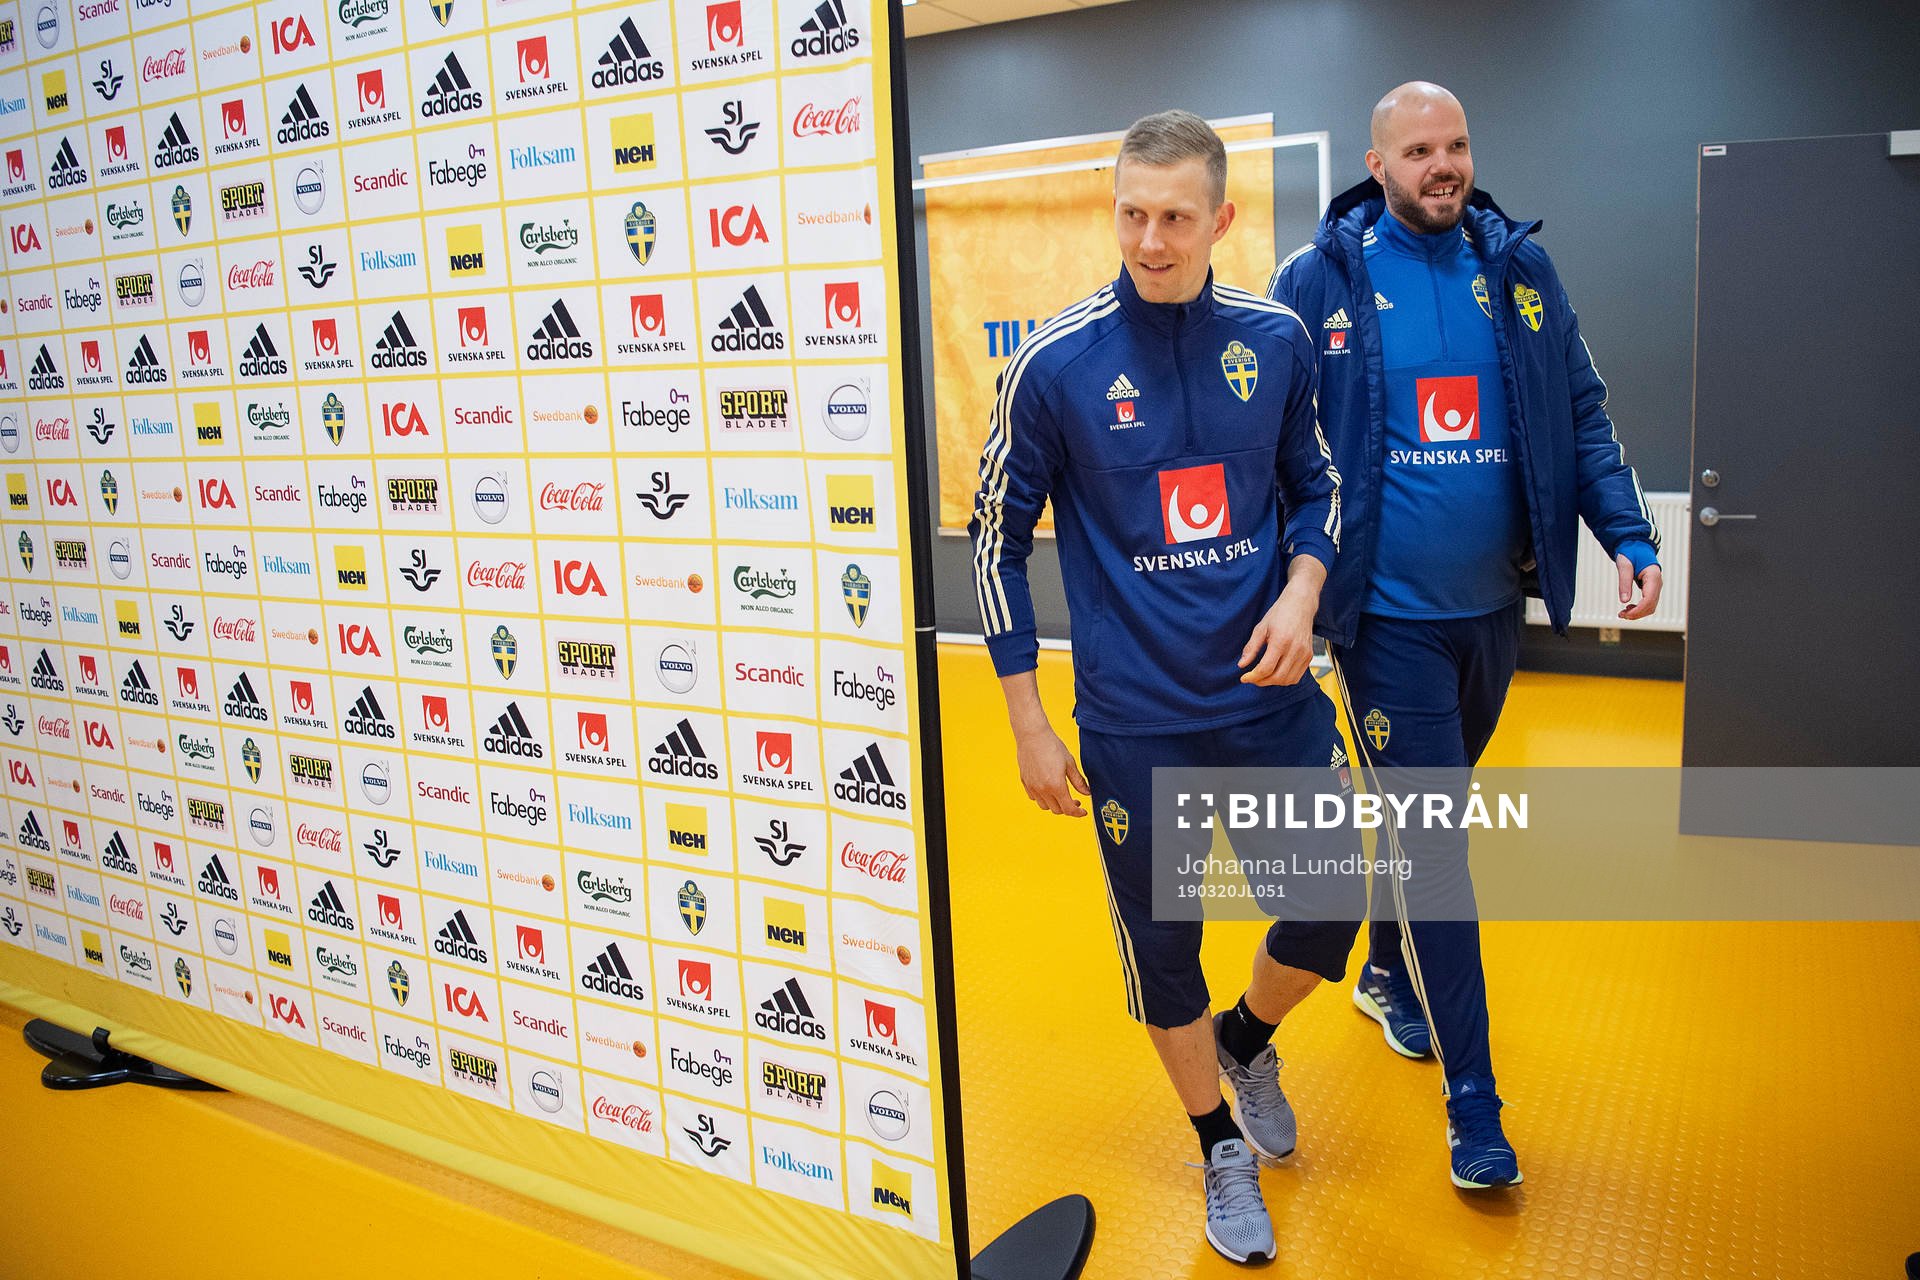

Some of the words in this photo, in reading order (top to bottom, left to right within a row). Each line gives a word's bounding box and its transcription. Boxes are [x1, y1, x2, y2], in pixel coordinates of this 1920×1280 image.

[338, 0, 389, 22] Carlsberg
[692, 55, 738, 71] SVENSKA
[741, 50, 762, 63] SPEL
[591, 60, 664, 90] adidas
[421, 90, 482, 117] adidas
[505, 86, 545, 101] SVENSKA
[547, 82, 568, 94] SPEL
[723, 100, 743, 126] SJ
[509, 145, 576, 170] Folksam
[48, 167, 87, 189] adidas
[428, 160, 487, 187] Fabege
[220, 181, 265, 210] SPORT
[709, 203, 769, 248] ICA
[797, 209, 863, 226] Swedbank
[519, 221, 579, 251] Carlsberg
[114, 273, 153, 299] SPORT
[17, 294, 53, 312] Scandic
[64, 288, 102, 312] Fabege
[119, 296, 153, 306] BLADET
[1376, 302, 1394, 311] das
[711, 322, 784, 352] adidas
[1323, 321, 1353, 329] adidas
[526, 332, 593, 361] adidas
[618, 343, 660, 354] SVENSKA
[663, 342, 685, 352] SPEL
[805, 335, 856, 346] SVENSKA
[858, 334, 877, 344] SPEL
[125, 358, 167, 384] adidas
[182, 369, 209, 378] SVENSKA
[209, 368, 224, 376] SPEL
[1227, 357, 1252, 365] SVERIGE
[28, 366, 64, 390] adidas
[719, 389, 788, 420] SPORT
[1106, 388, 1141, 401] adidas
[382, 401, 429, 437] ICA
[454, 405, 513, 426] Scandic
[532, 409, 582, 422] Swedbank
[622, 399, 691, 434] Fabege
[829, 404, 866, 415] VOLVO
[724, 419, 788, 429] BLADET
[1109, 423, 1133, 432] SVENSKA
[1133, 421, 1146, 429] SPEL
[1390, 450, 1471, 465] SVENSKA
[1475, 448, 1509, 464] SPEL
[47, 478, 78, 507] ICA
[387, 477, 438, 504] SPORT
[651, 471, 670, 495] SJ
[392, 502, 438, 512] BLADET
[476, 492, 503, 503] VOLVO
[539, 481, 606, 513] Coca-Cola
[724, 486, 799, 511] Folksam
[411, 548, 427, 569] SJ
[1133, 547, 1221, 573] SVENSKA
[1224, 538, 1260, 562] SPEL
[467, 560, 527, 591] Coca-Cola
[553, 559, 608, 597] ICA
[634, 574, 686, 590] Swedbank
[733, 565, 797, 597] Carlsberg
[172, 604, 184, 622] SJ
[338, 623, 381, 658] ICA
[557, 641, 616, 669] SPORT
[661, 661, 692, 672] VOLVO
[31, 675, 64, 692] adidas
[562, 666, 616, 679] BLADET
[735, 662, 805, 687] Scandic
[75, 686, 97, 695] SVENSKA
[97, 689, 109, 697] SPEL
[833, 670, 896, 711] Fabege
[284, 716, 312, 726] SVENSKA
[313, 720, 328, 729] SPEL
[178, 733, 215, 760] Carlsberg
[413, 733, 446, 744] SVENSKA
[447, 737, 464, 747] SPEL
[483, 734, 543, 759] adidas
[290, 755, 333, 782] SPORT
[565, 752, 604, 766] SVENSKA
[605, 756, 627, 768] SPEL
[648, 754, 719, 782] adidas
[743, 774, 784, 789] SVENSKA
[788, 780, 813, 791] SPEL
[137, 792, 174, 821] Fabege
[834, 781, 907, 811] adidas
[490, 791, 547, 826] Fabege
[568, 802, 633, 830] Folksam
[769, 819, 789, 843] SJ
[424, 849, 478, 878] Folksam
[840, 841, 909, 884] Coca-Cola
[197, 876, 238, 902] adidas
[496, 868, 541, 887] Swedbank
[577, 869, 633, 903] Carlsberg
[66, 884, 100, 907] Folksam
[252, 897, 278, 909] SVENSKA
[279, 904, 293, 914] SPEL
[5, 907, 15, 924] SJ
[34, 923, 67, 946] Folksam
[842, 934, 896, 956] Swedbank
[434, 935, 487, 964] adidas
[506, 961, 540, 975] SVENSKA
[542, 969, 560, 980] SPEL
[581, 971, 644, 1002] adidas
[444, 982, 489, 1022] ICA
[667, 997, 705, 1013] SVENSKA
[708, 1007, 730, 1018] SPEL
[513, 1009, 568, 1039] Scandic
[754, 1008, 826, 1041] adidas
[585, 1030, 631, 1052] Swedbank
[850, 1039, 894, 1058] SVENSKA
[895, 1051, 917, 1066] SPEL
[450, 1048, 497, 1082] SPORT
[670, 1047, 732, 1088] Fabege
[454, 1071, 496, 1090] BLADET
[531, 1081, 559, 1099] VOLVO
[762, 1062, 826, 1102] SPORT
[766, 1088, 824, 1110] BLADET
[592, 1095, 652, 1134] Coca-Cola
[697, 1113, 716, 1135] SJ
[869, 1104, 905, 1122] VOLVO
[762, 1146, 834, 1182] Folksam
